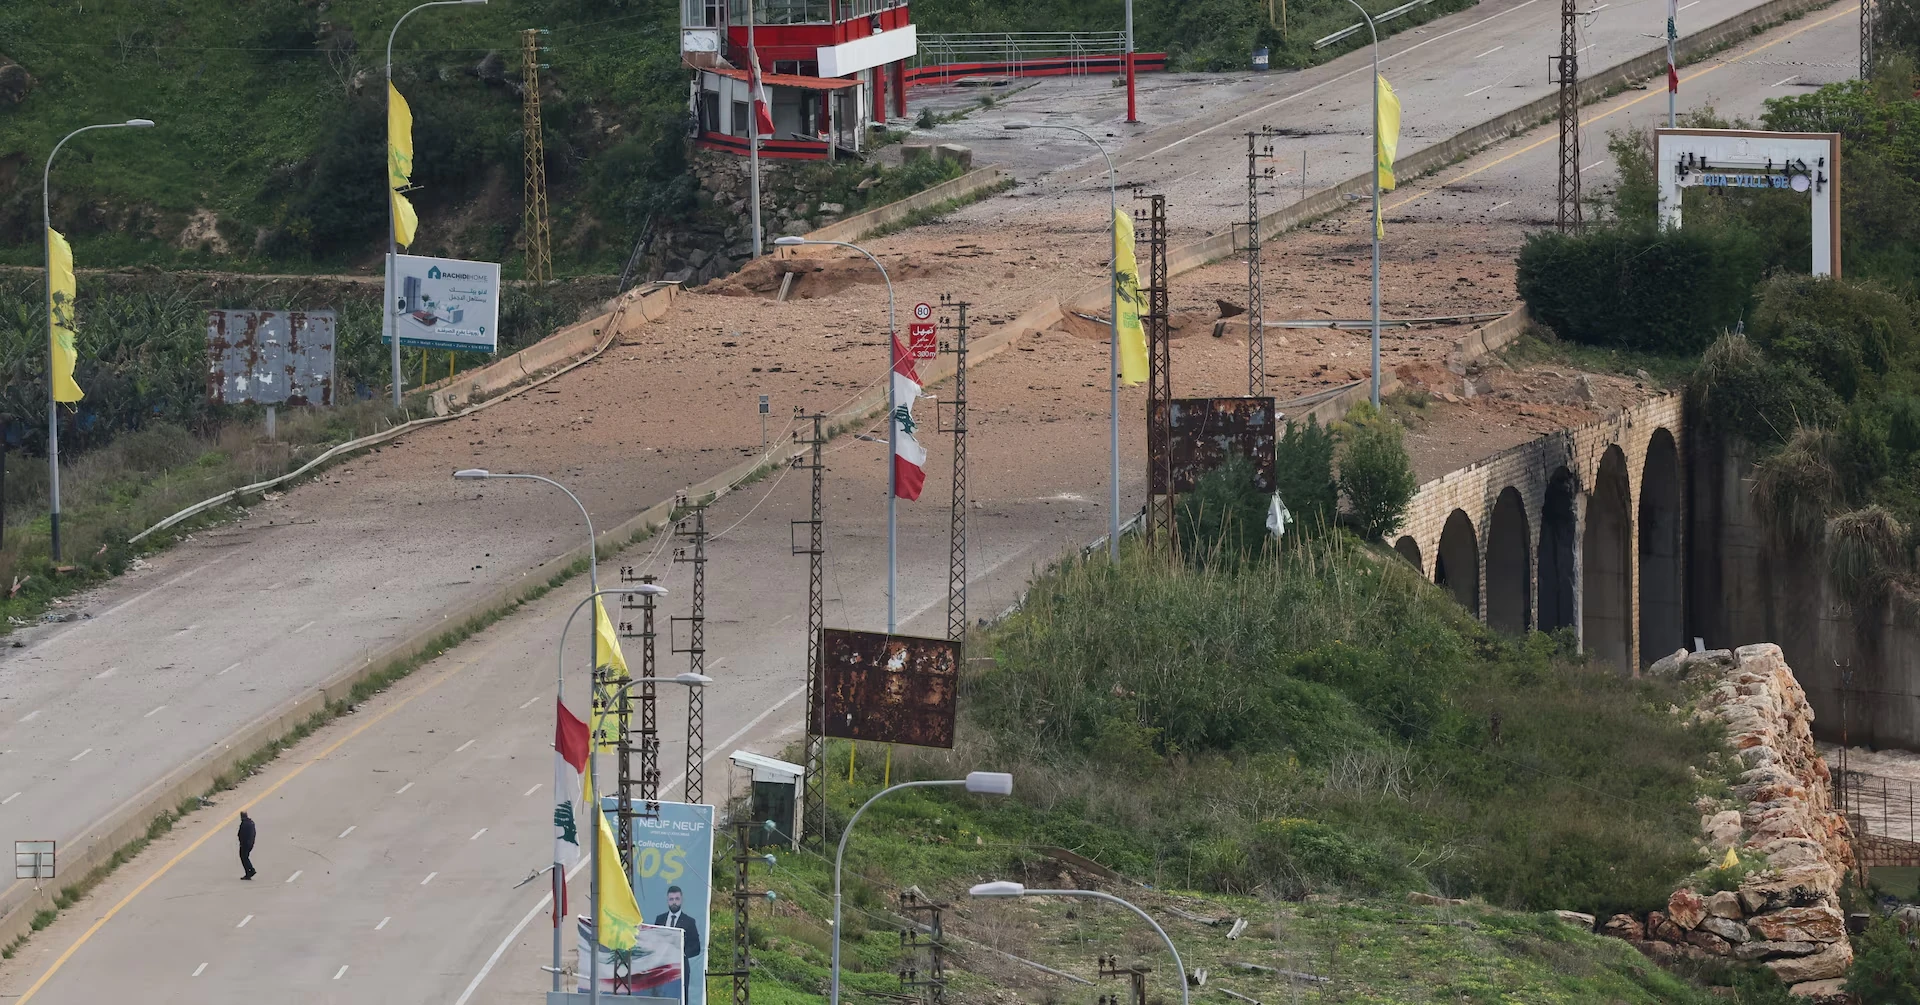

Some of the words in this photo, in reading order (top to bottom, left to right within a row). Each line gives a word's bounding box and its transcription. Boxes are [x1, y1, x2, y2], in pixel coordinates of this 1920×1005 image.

[917, 307, 929, 316] 80
[639, 819, 670, 829] NEUF
[673, 820, 705, 832] NEUF
[637, 840, 675, 850] Collection
